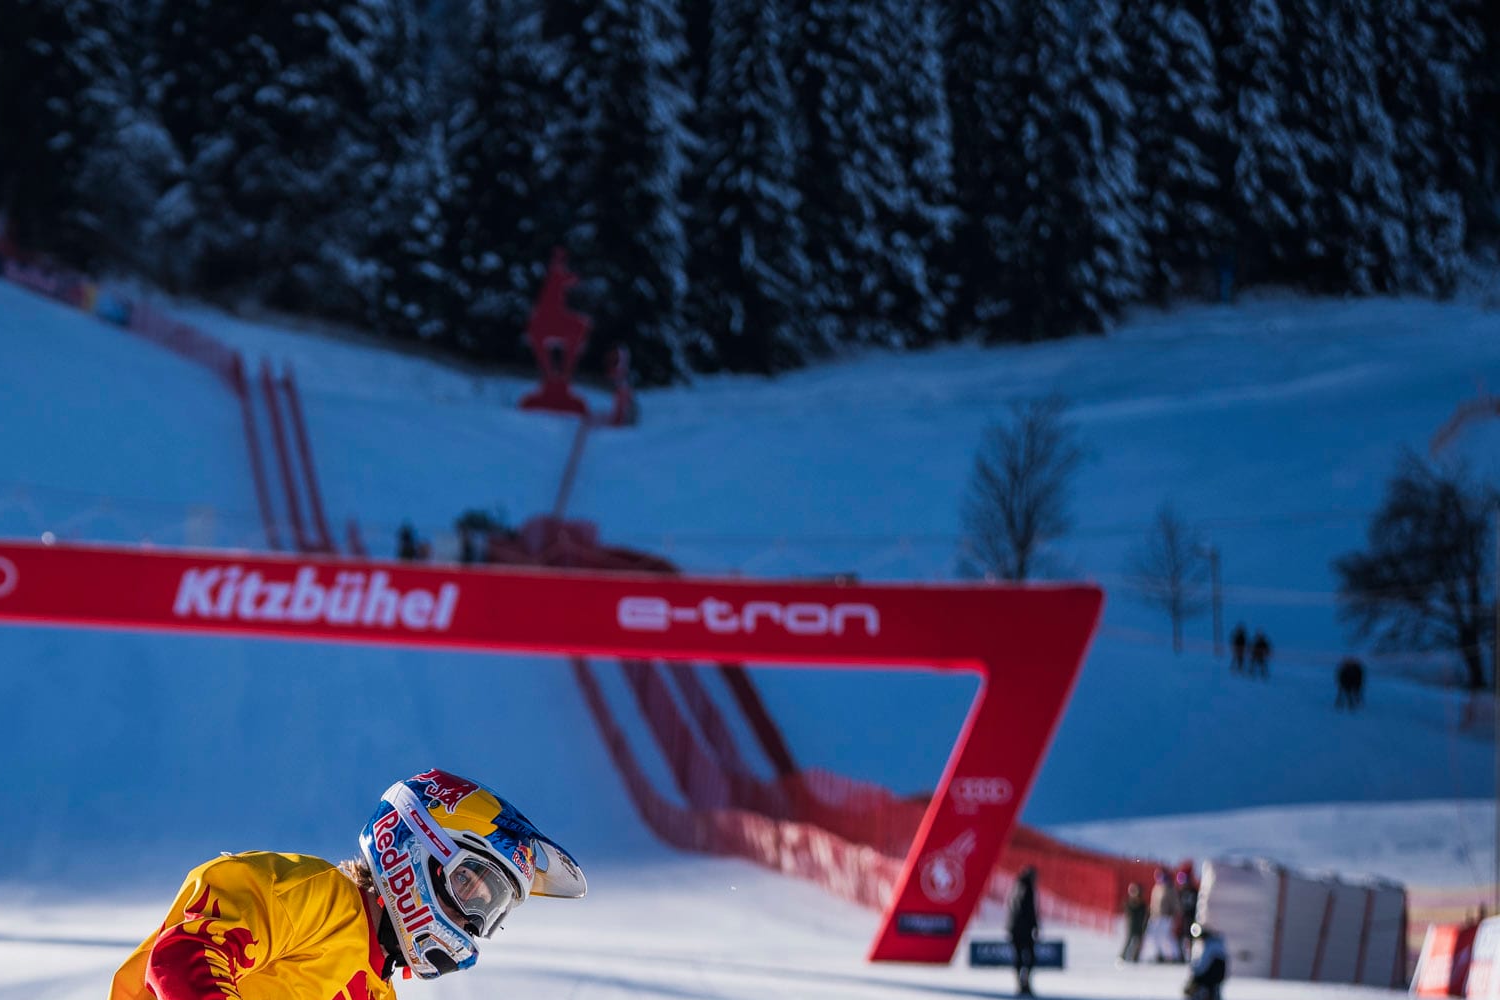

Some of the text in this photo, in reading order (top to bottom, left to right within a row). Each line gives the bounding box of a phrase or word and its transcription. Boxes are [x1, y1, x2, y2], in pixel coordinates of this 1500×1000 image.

[173, 566, 459, 629] Kitzbühel
[617, 596, 880, 636] e-tron
[373, 810, 410, 872] Red
[388, 864, 434, 933] Bull
